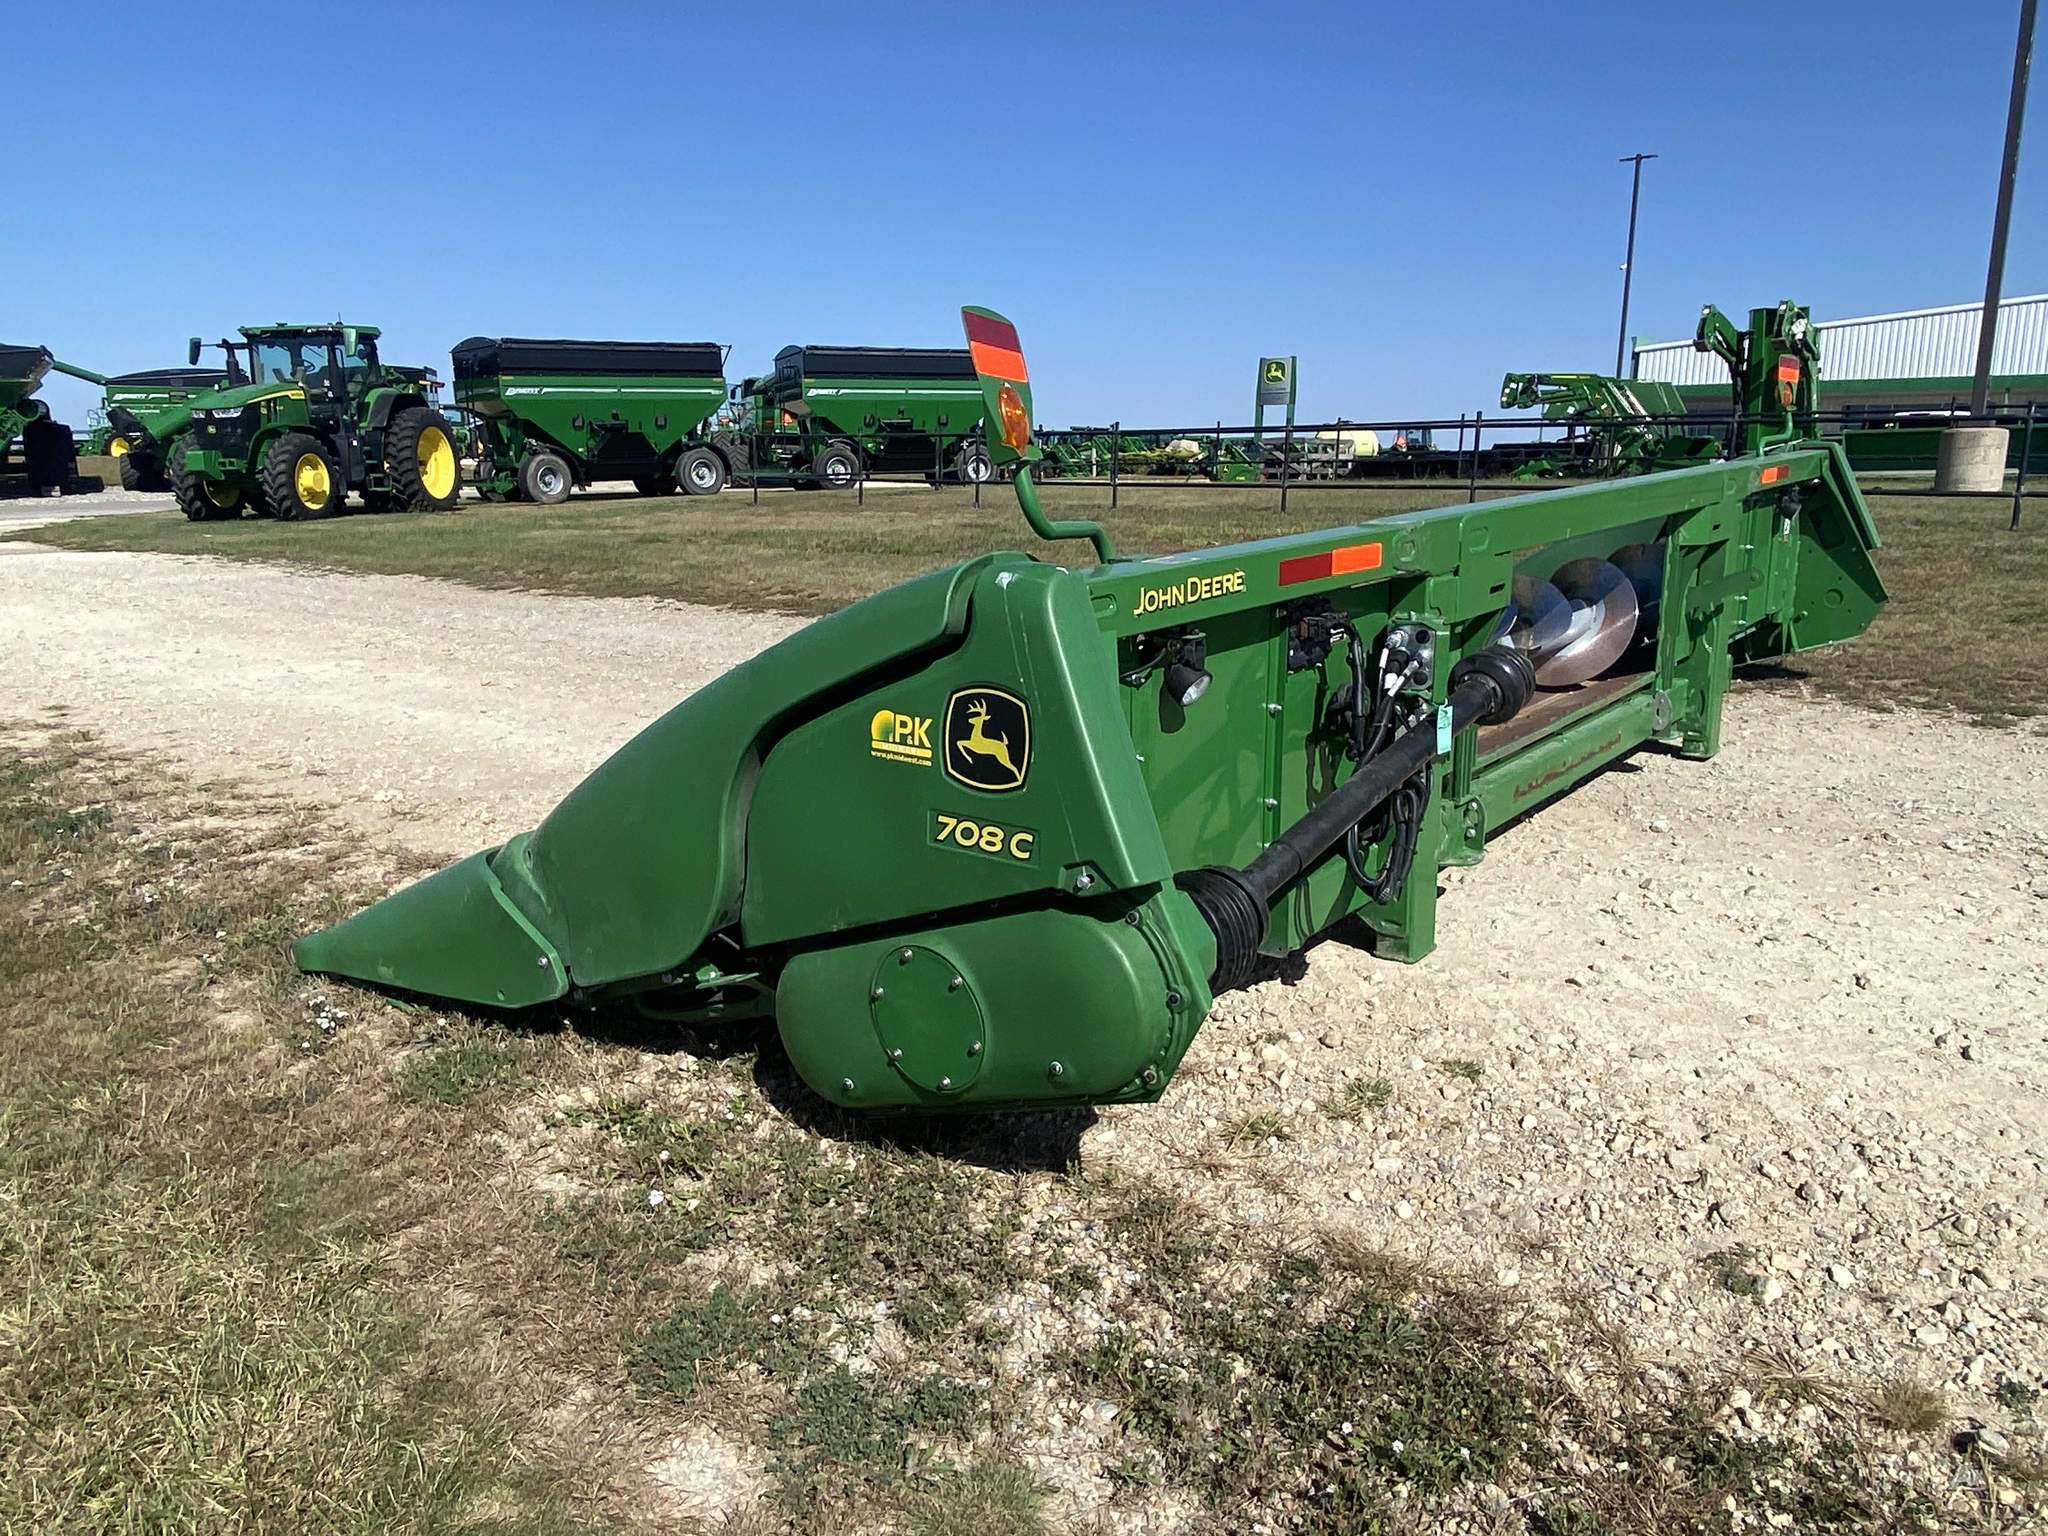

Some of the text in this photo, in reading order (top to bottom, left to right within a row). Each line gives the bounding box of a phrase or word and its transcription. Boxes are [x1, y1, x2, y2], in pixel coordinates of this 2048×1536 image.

[1133, 570, 1246, 615] JOHN DEERE
[936, 814, 1034, 860] 708 C
